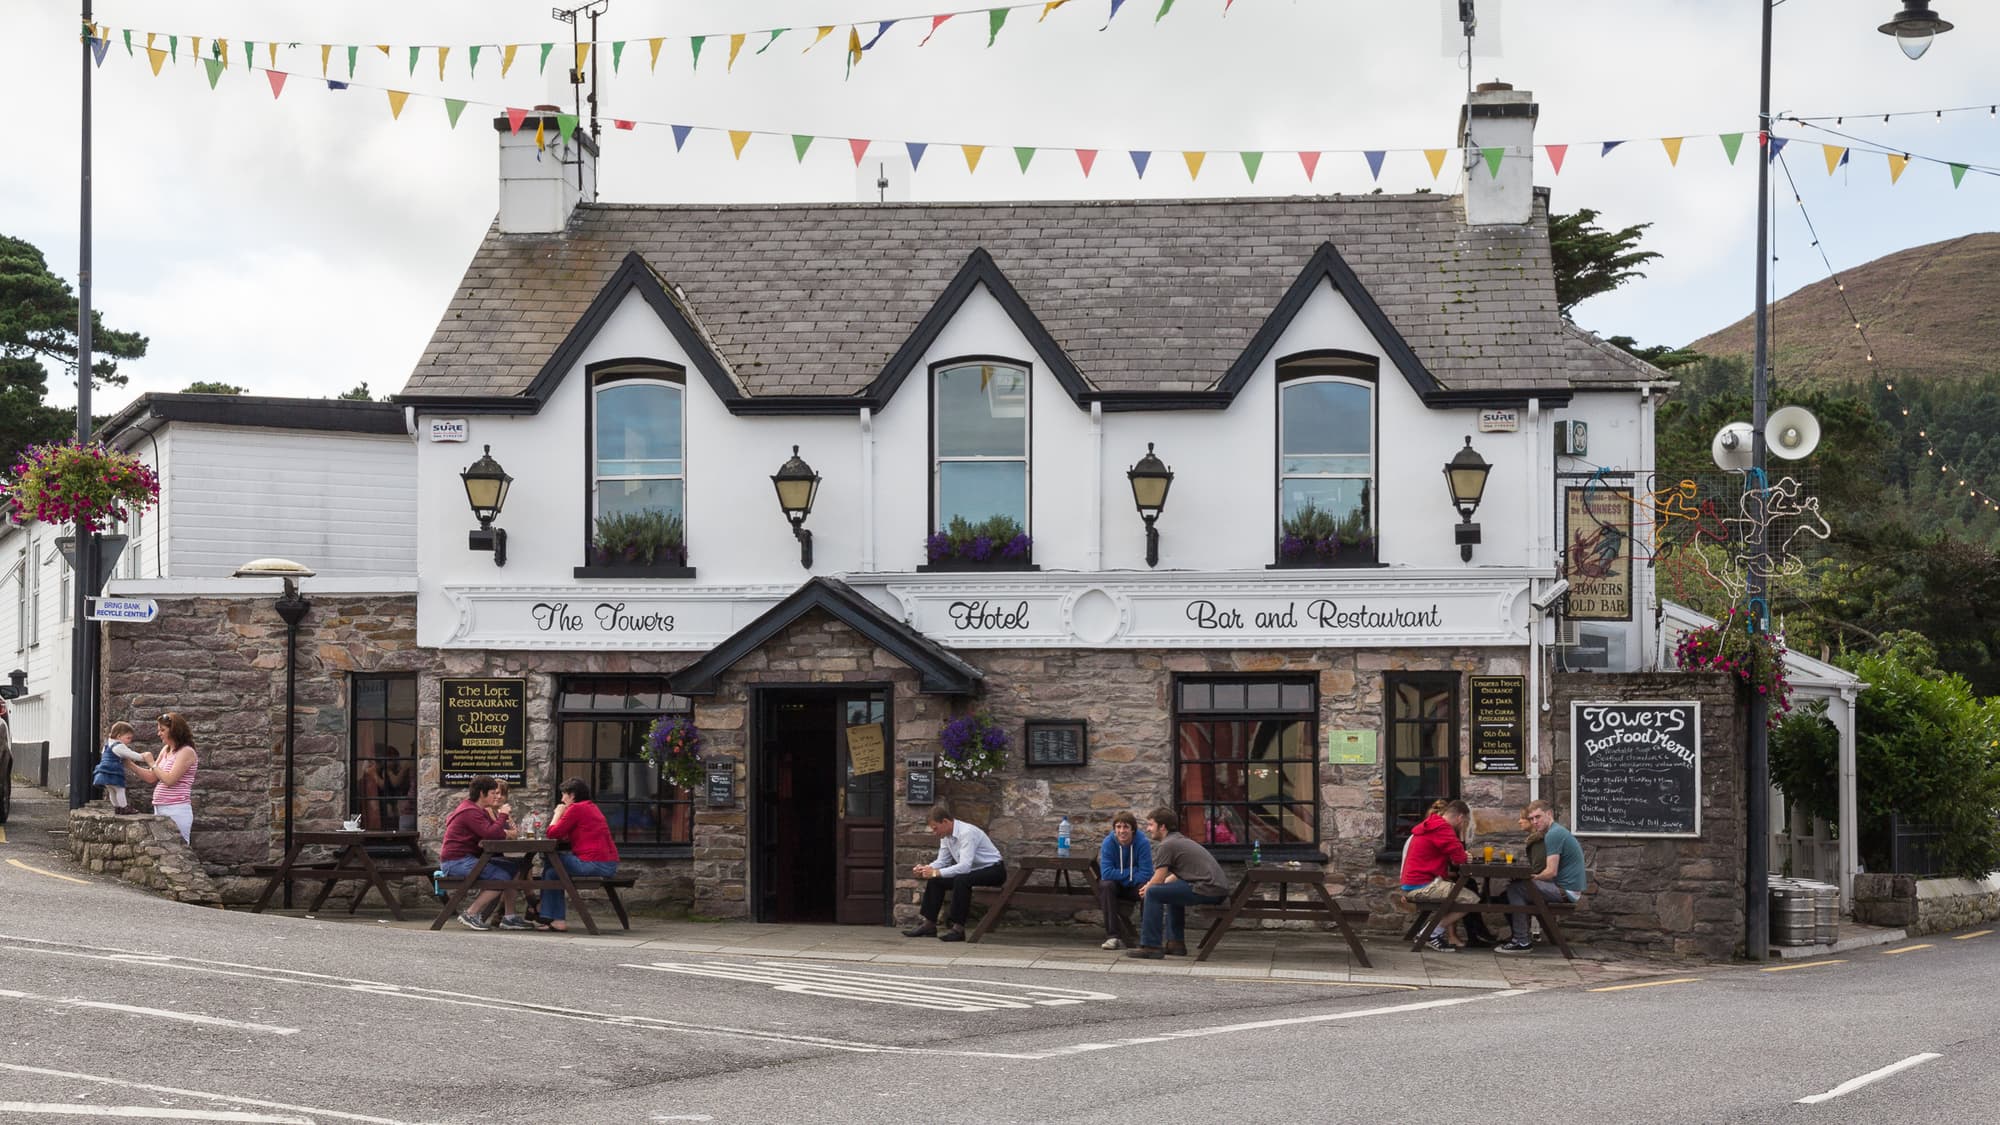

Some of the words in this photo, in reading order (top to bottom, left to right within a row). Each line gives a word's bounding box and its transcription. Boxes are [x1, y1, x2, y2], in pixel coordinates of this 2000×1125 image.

[432, 424, 464, 432] SURE
[1575, 582, 1623, 595] TOWERS
[104, 601, 122, 609] BRING
[1572, 599, 1595, 612] OLD
[1601, 599, 1625, 612] BAR
[97, 609, 122, 617] RECYCLE
[124, 610, 147, 618] CENTRE
[532, 602, 583, 631] The
[594, 602, 674, 632] Towers
[948, 600, 1030, 630] Hotel
[1186, 600, 1244, 629] Bar
[1255, 602, 1298, 629] and
[1307, 599, 1442, 629] Restaurant
[1651, 729, 1696, 765] Menu
